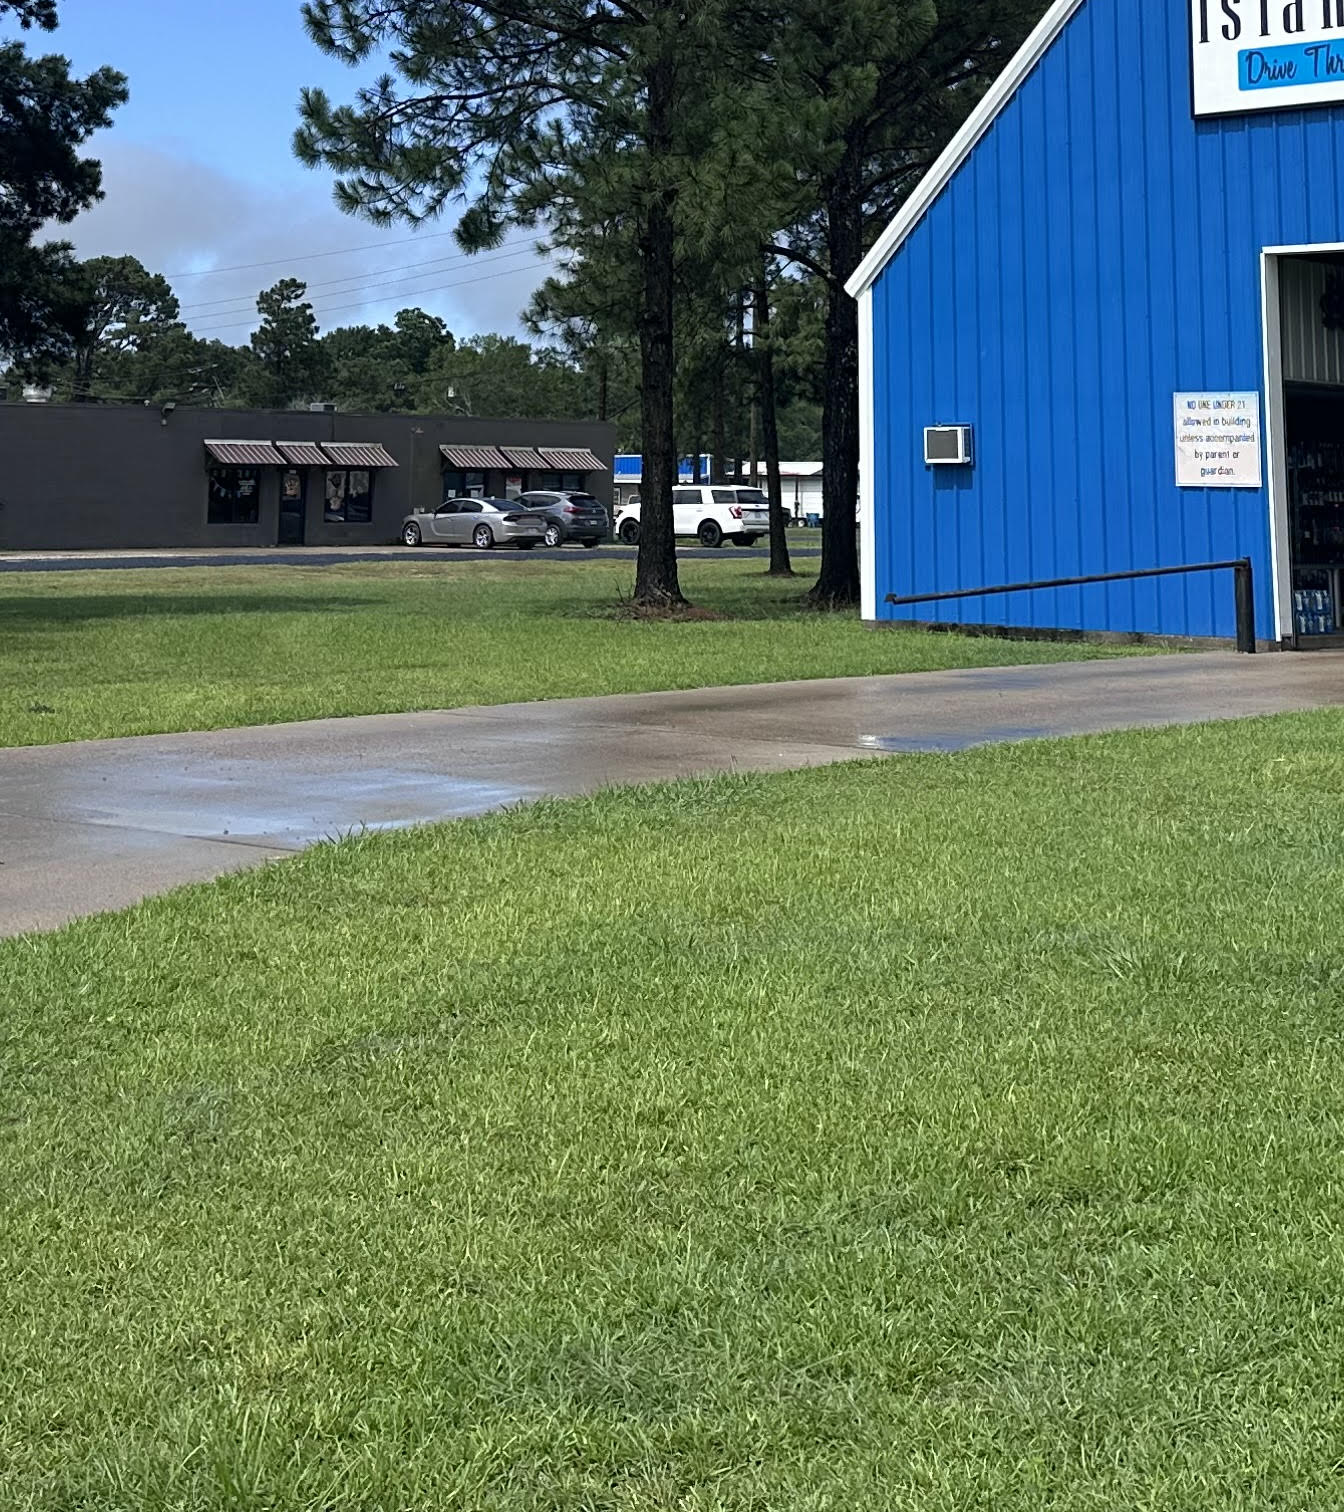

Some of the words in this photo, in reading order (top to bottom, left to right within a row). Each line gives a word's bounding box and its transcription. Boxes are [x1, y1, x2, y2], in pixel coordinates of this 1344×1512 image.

[1245, 50, 1297, 85] Drive
[1183, 417, 1211, 426] allowed
[1221, 417, 1251, 428] building
[1180, 434, 1203, 442] unless
[1194, 448, 1203, 460] by
[1205, 450, 1230, 460] parent
